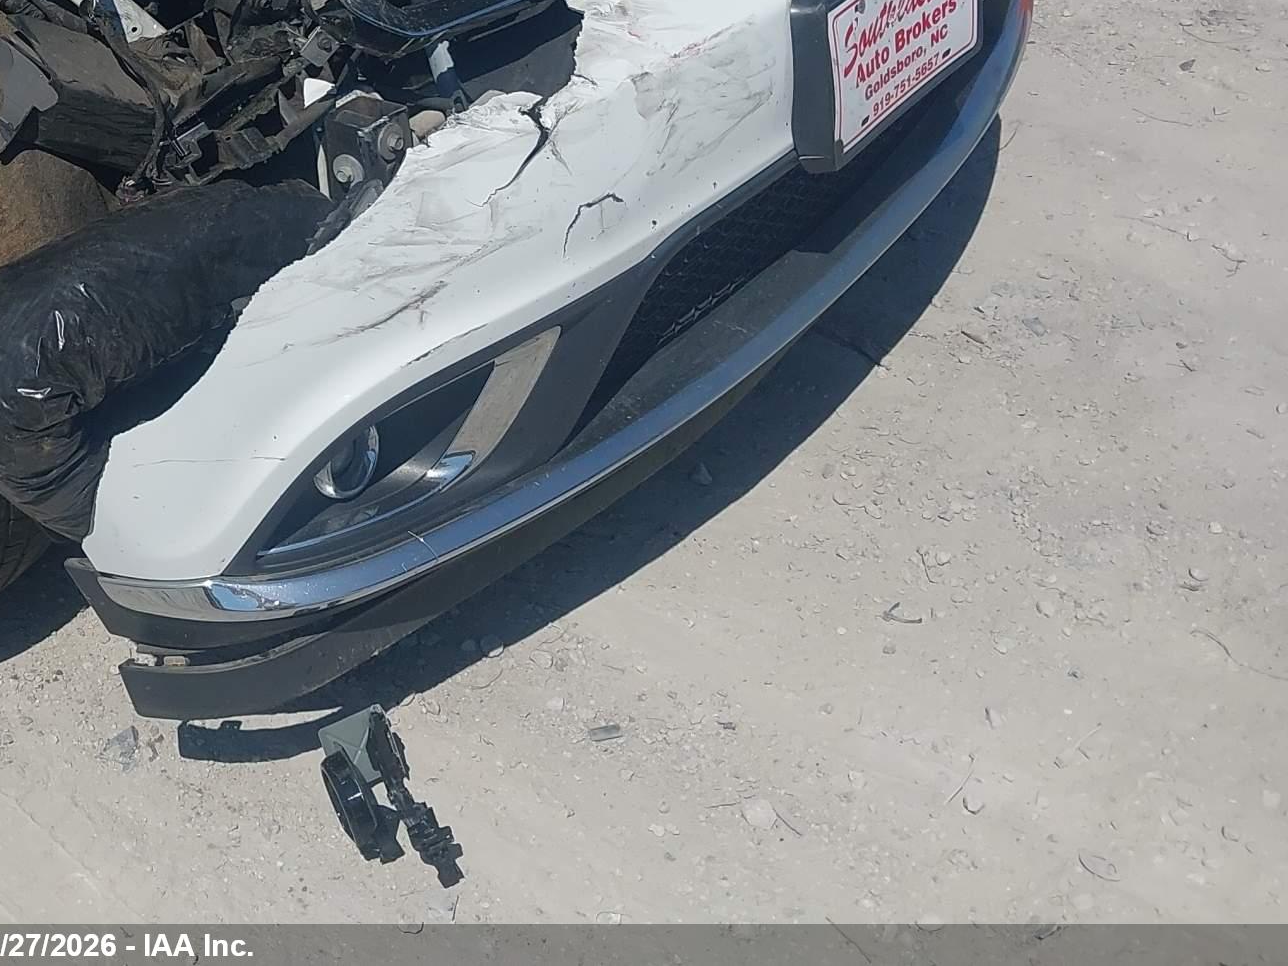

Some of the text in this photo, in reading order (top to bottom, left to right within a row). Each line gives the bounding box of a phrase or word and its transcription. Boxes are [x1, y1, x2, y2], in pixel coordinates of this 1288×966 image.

[856, 46, 890, 88] Auto
[864, 23, 949, 101] Goldsboro, NC
[872, 51, 941, 117] 919-751-5657
